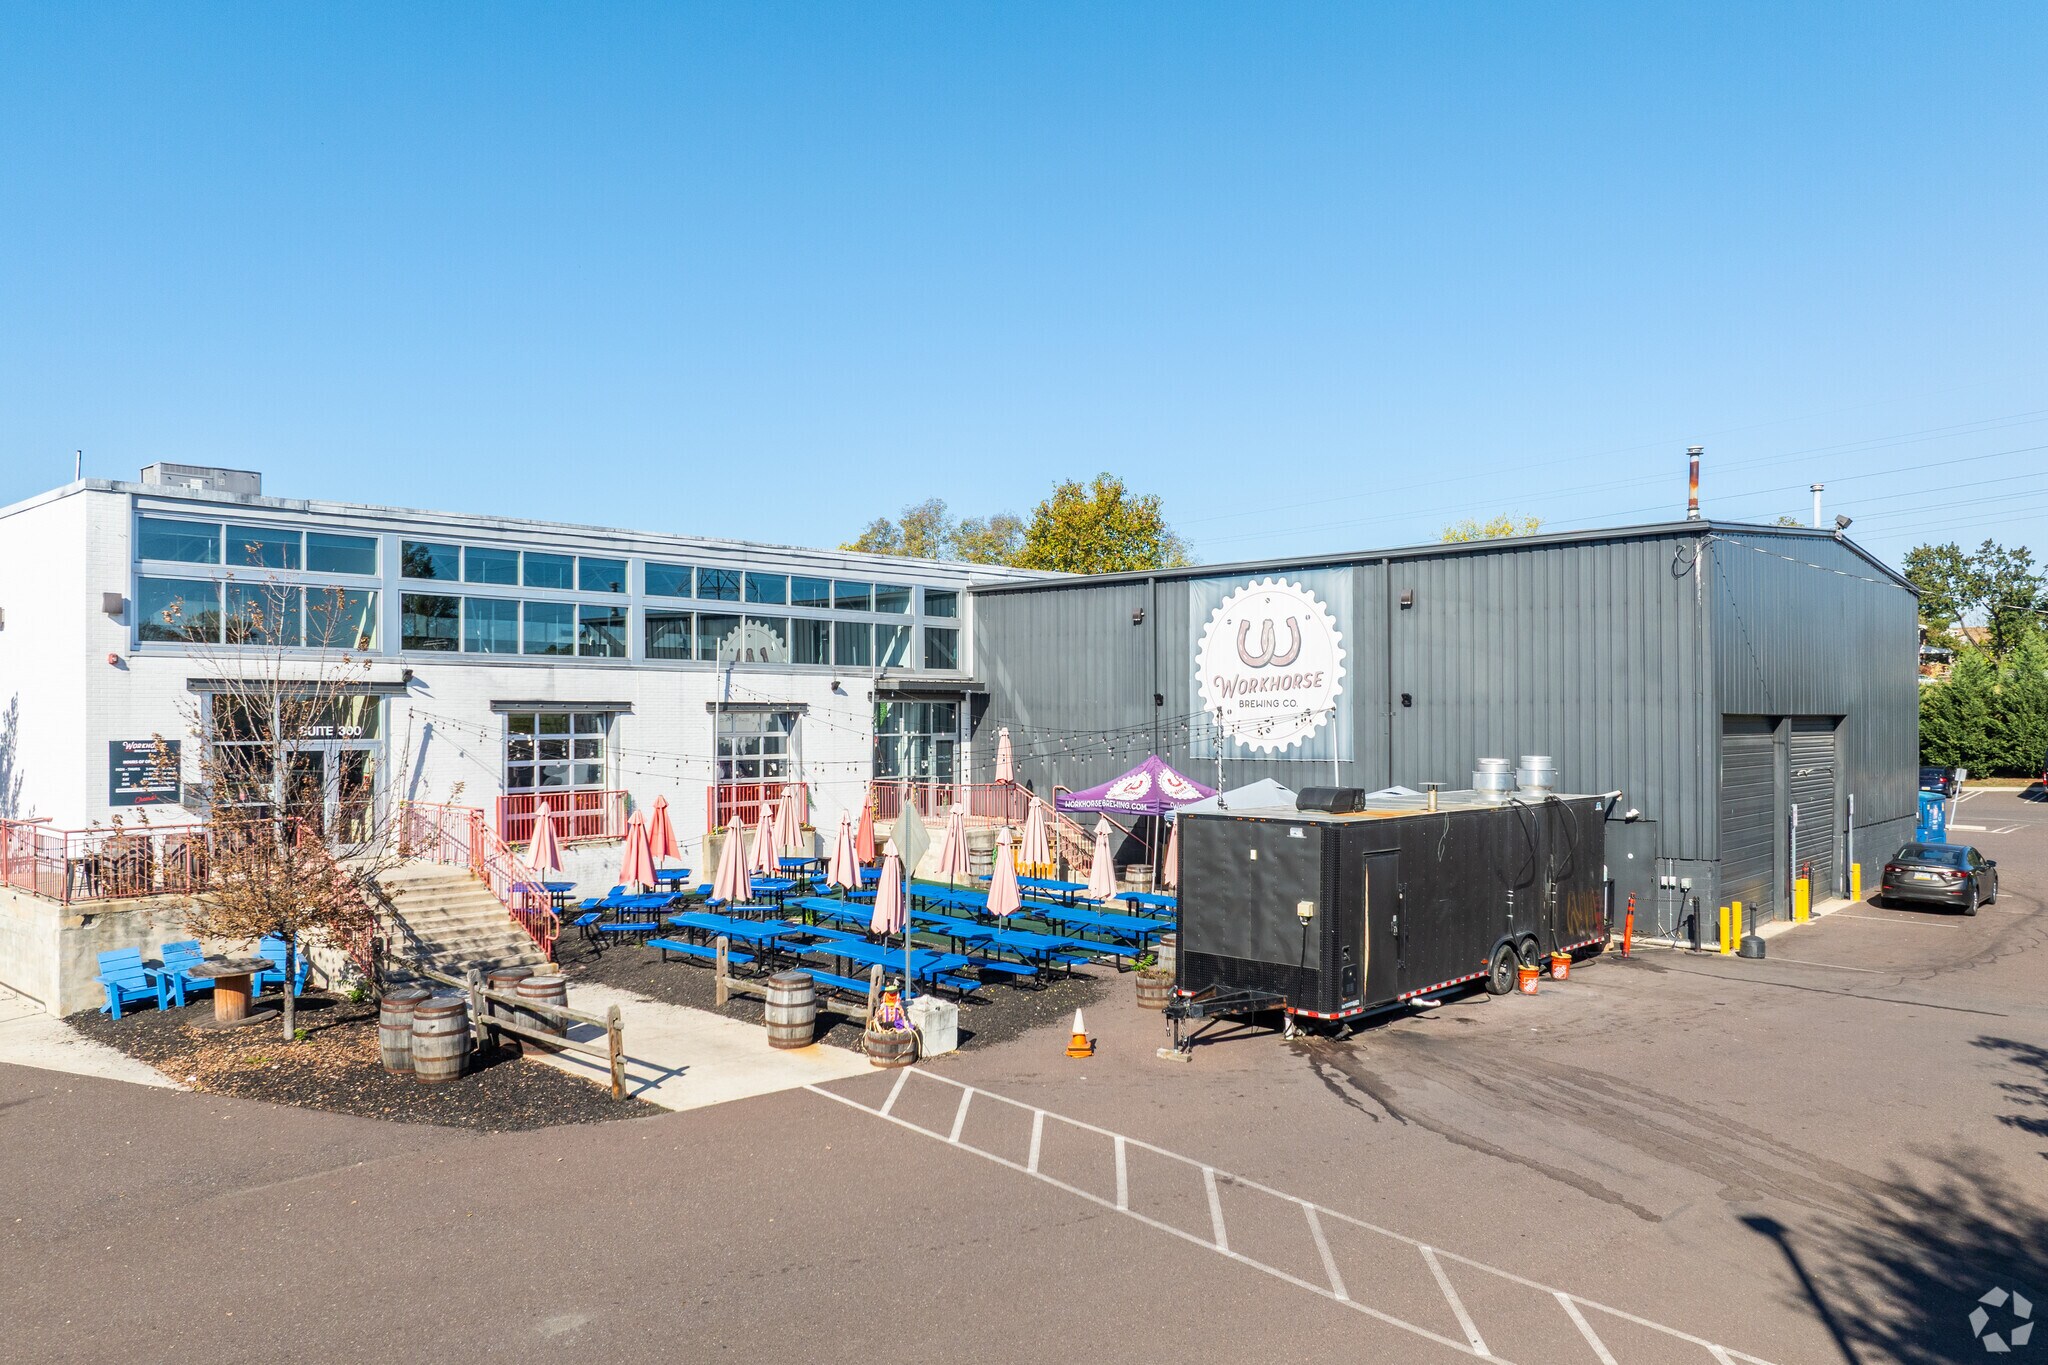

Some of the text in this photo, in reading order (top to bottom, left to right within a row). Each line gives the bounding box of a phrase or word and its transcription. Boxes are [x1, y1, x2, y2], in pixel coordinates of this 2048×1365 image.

[1213, 671, 1325, 699] WORKHORSE
[1239, 699, 1299, 708] BREWING CO.
[338, 726, 362, 736] 300
[1064, 800, 1148, 811] WORKHORSEBREWING.COM
